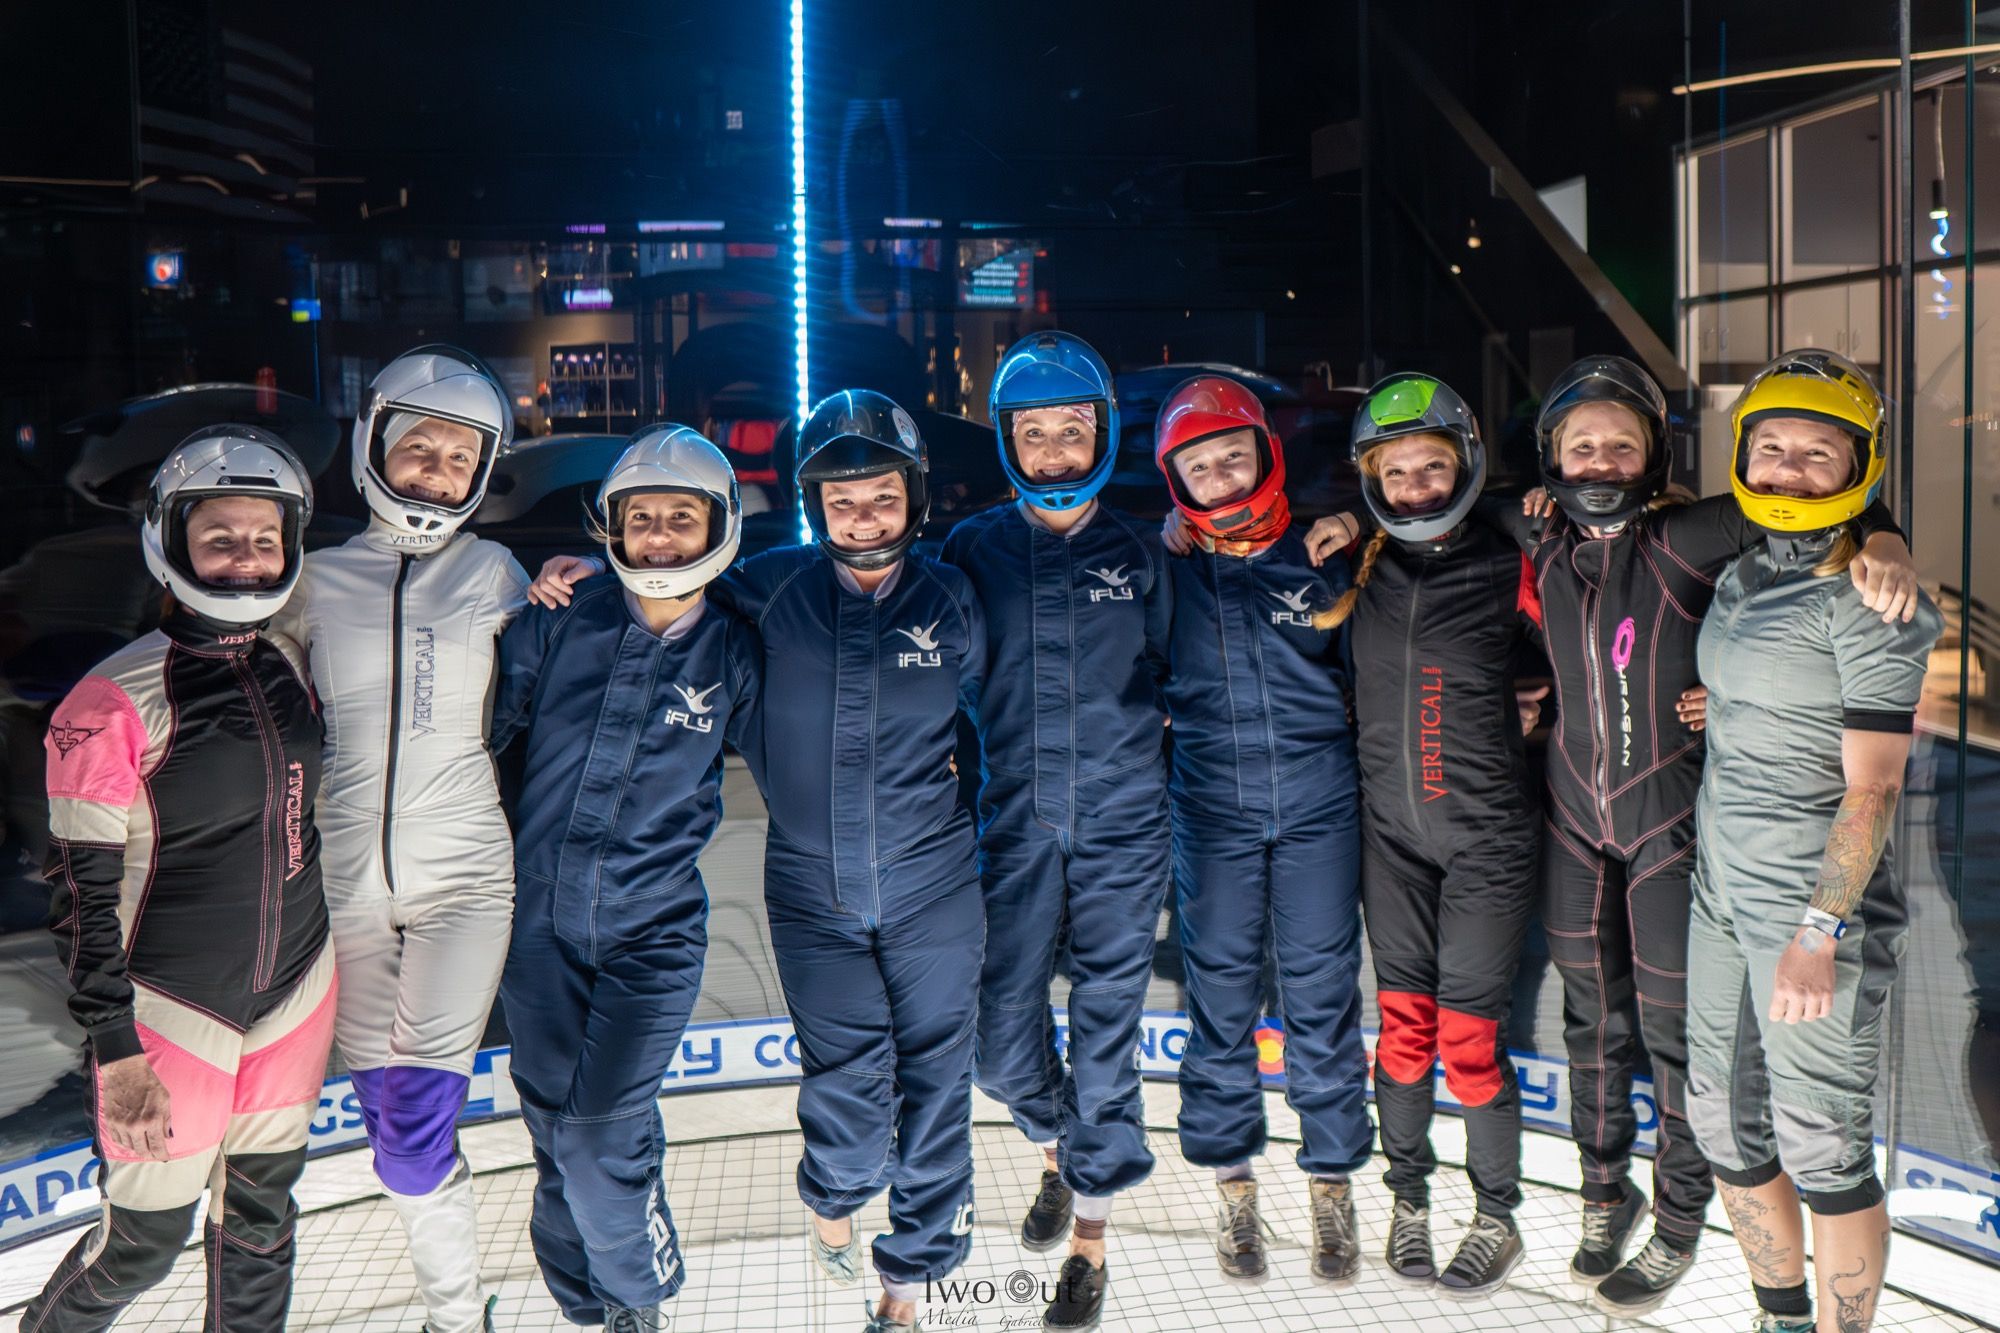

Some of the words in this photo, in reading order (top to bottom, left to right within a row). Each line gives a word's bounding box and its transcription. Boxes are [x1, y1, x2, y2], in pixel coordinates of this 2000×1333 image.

[1089, 587, 1134, 602] iFLY
[1271, 612, 1313, 627] iFLY
[898, 652, 942, 668] iFLY
[409, 634, 436, 742] VERTICAL
[664, 709, 713, 733] iFLY
[1422, 678, 1449, 803] VERTICAL
[285, 770, 304, 881] VERTICAL
